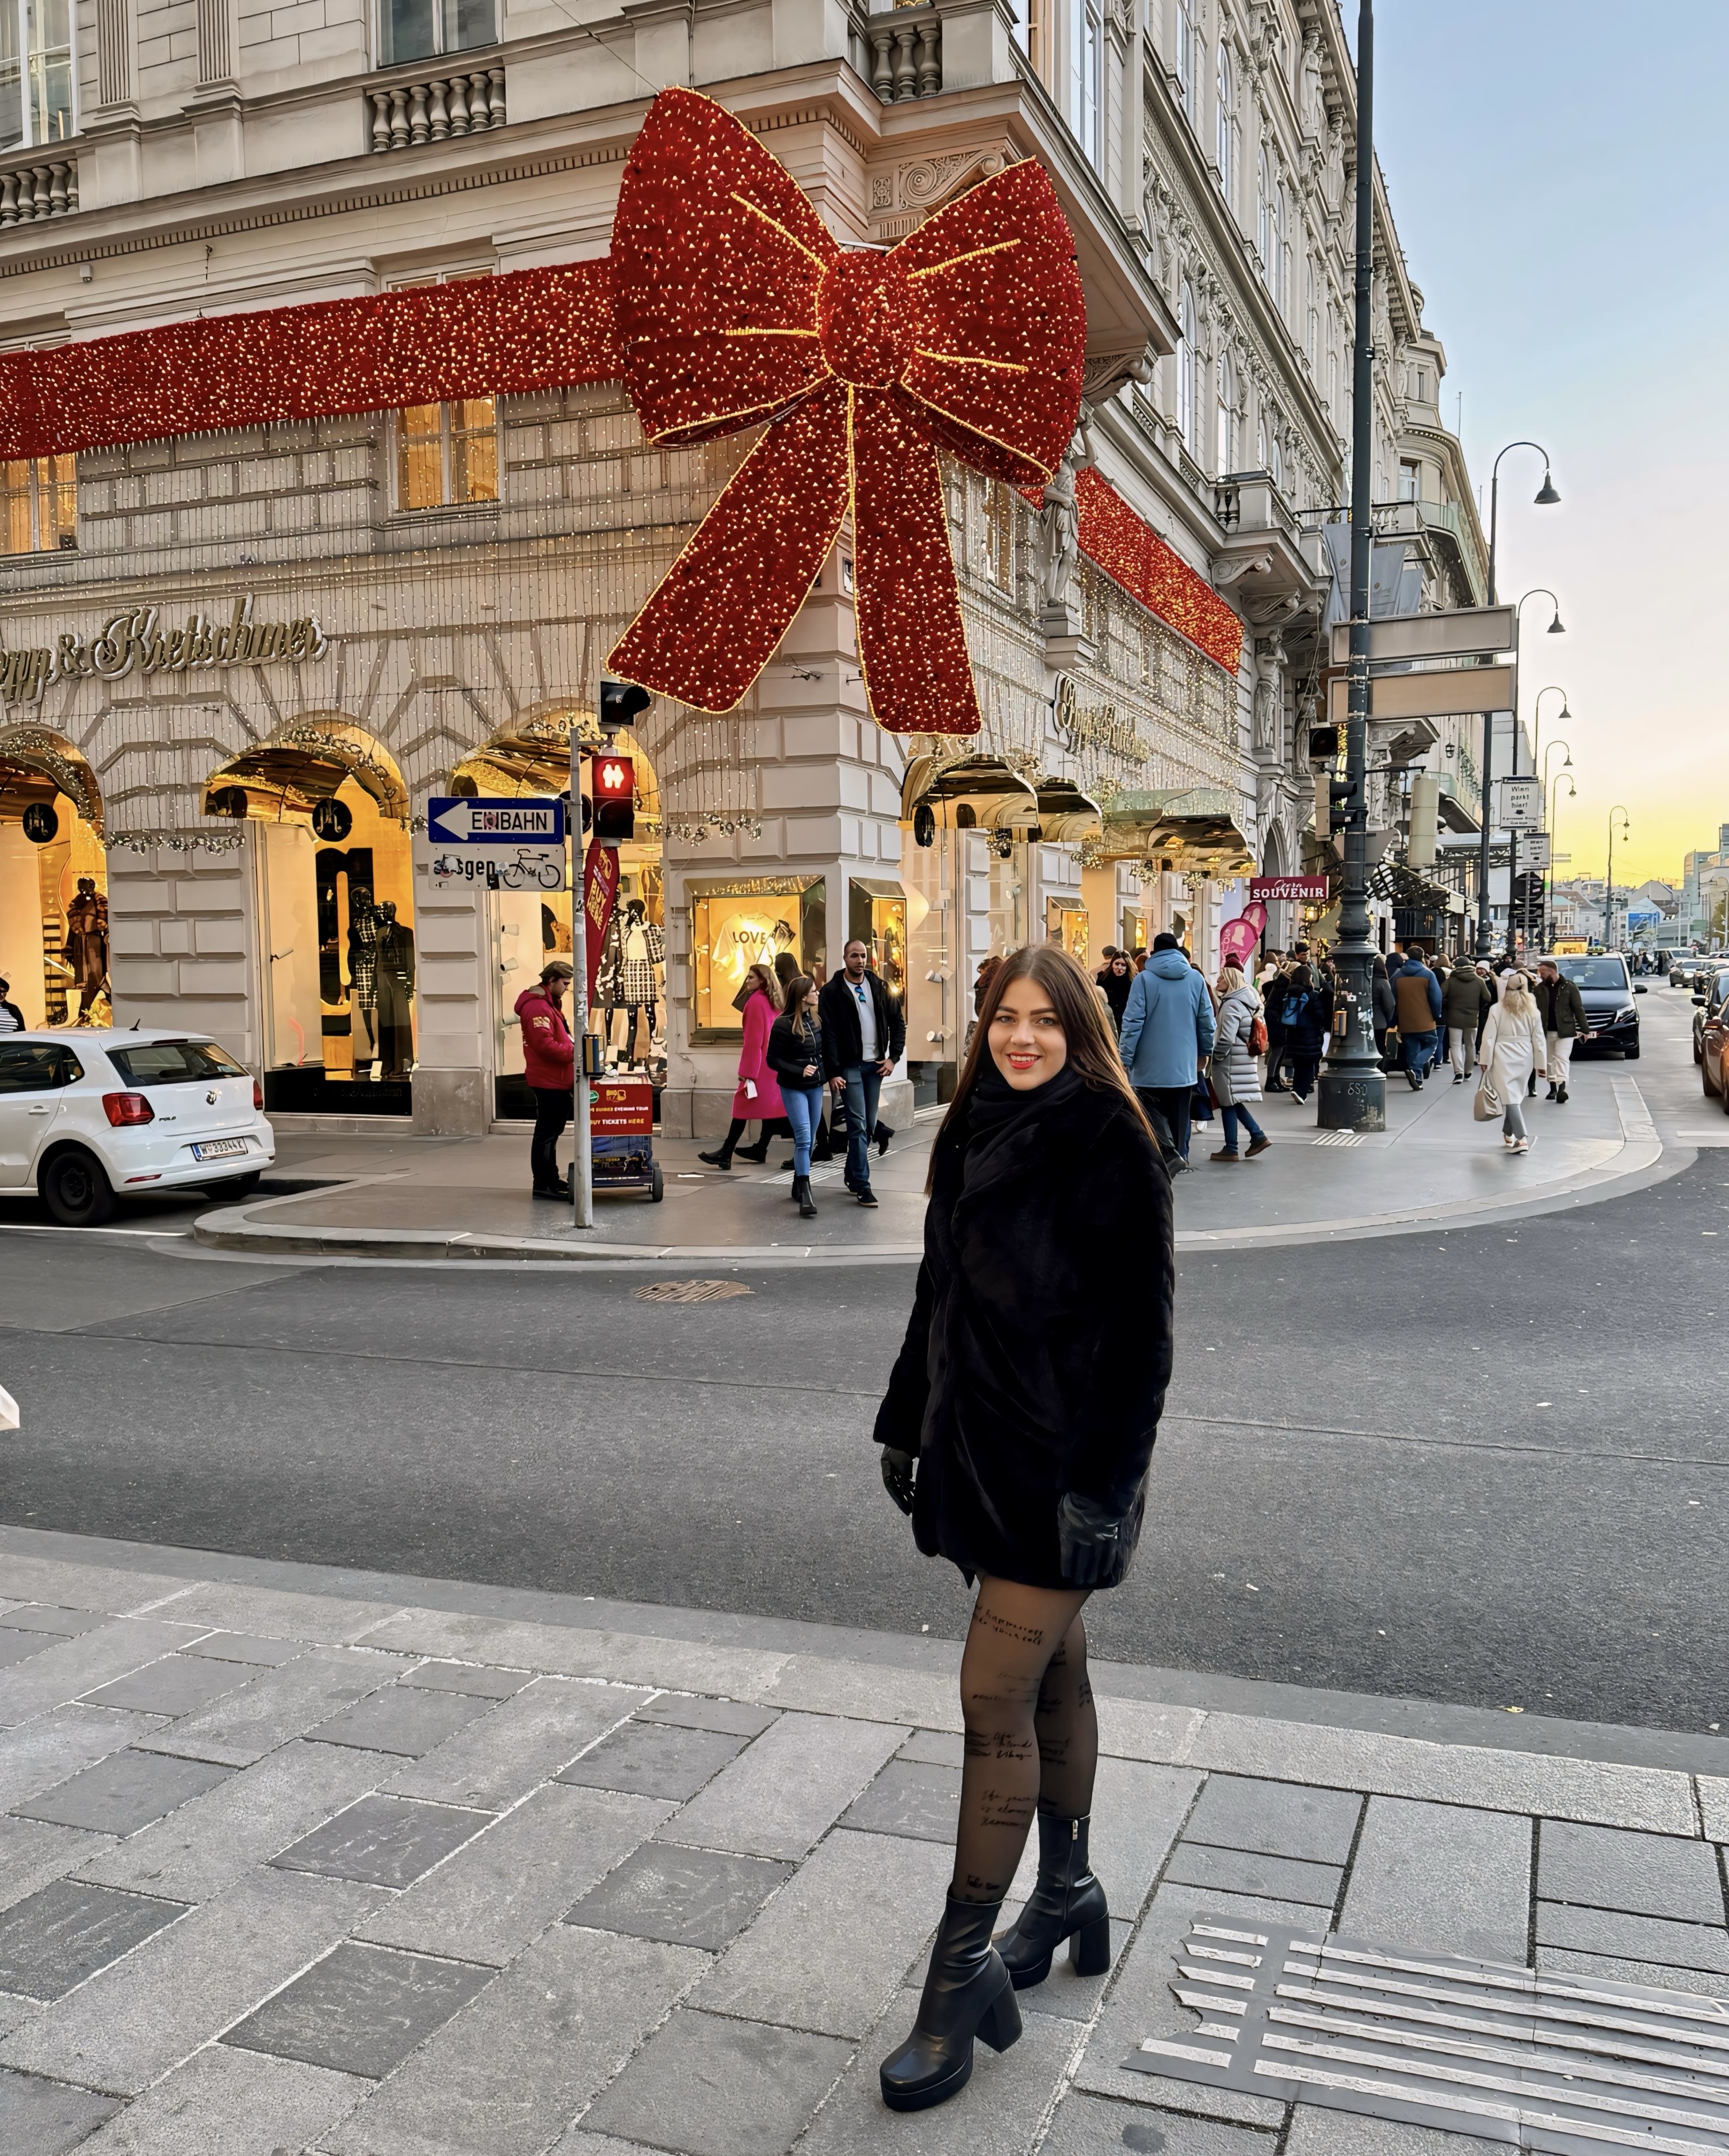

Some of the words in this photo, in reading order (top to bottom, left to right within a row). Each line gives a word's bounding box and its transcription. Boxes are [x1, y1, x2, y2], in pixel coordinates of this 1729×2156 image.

[58, 633, 85, 679] &
[90, 592, 327, 681] Kretschmer
[1253, 888, 1324, 899] SOUVENIR
[733, 931, 766, 945] LOVE
